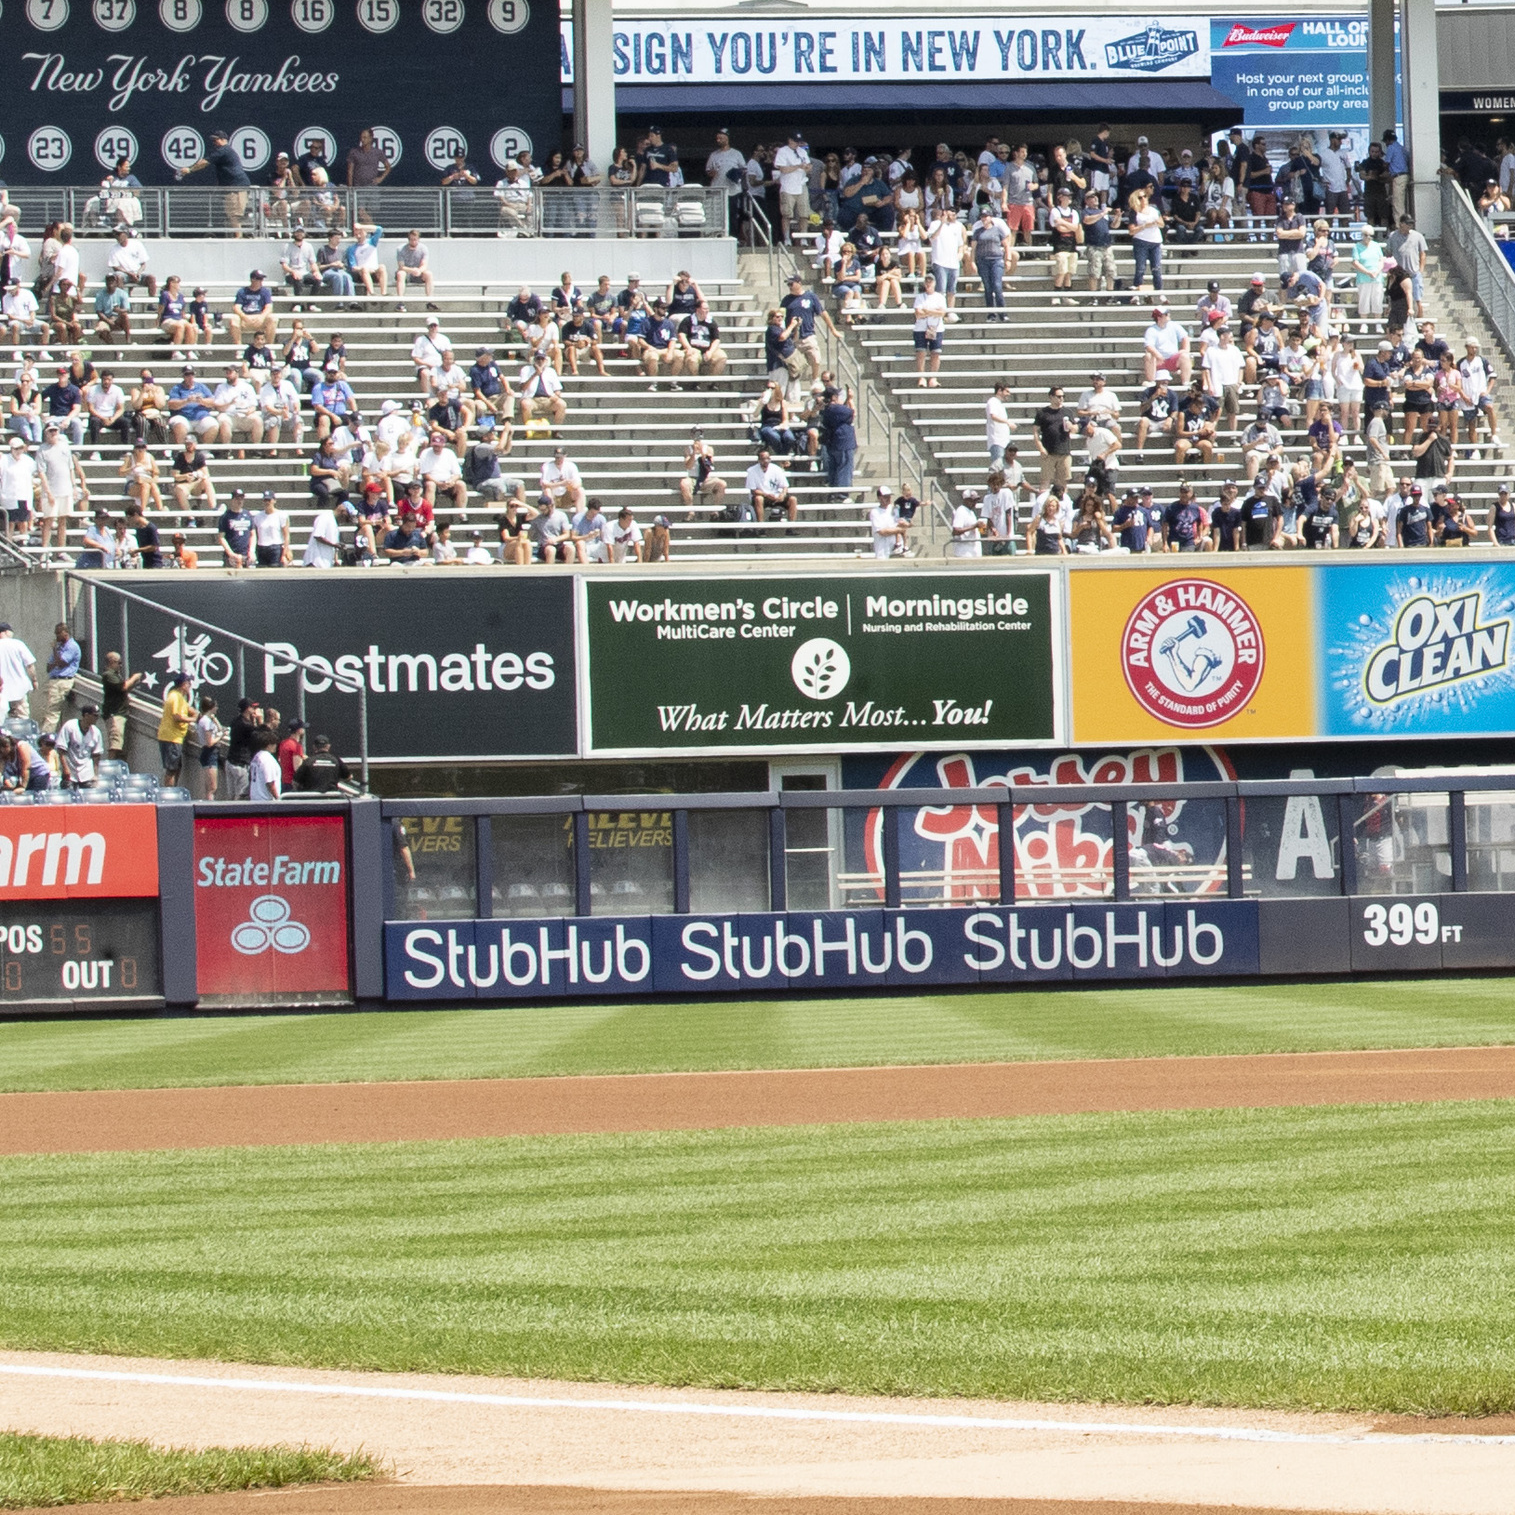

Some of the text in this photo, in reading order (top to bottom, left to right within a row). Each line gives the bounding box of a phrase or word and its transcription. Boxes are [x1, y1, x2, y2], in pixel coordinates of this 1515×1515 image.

[41, 0, 54, 19] 7
[100, 0, 128, 20] 37
[173, 0, 188, 20] 8
[240, 1, 254, 21] 8
[301, 1, 324, 22] 16
[367, 1, 390, 22] 15
[429, 2, 458, 23] 32
[501, 2, 516, 23] 9
[1229, 26, 1290, 42] Budweiser
[1303, 22, 1345, 35] HALL
[613, 31, 694, 75] SIGN
[708, 30, 839, 75] YOU'RE
[851, 31, 886, 73] IN
[903, 29, 982, 73] NEW
[994, 27, 1098, 72] YORK.
[1160, 32, 1195, 53] POINT
[1105, 44, 1146, 65] BLUE
[22, 52, 340, 113] New York Yankees
[1236, 73, 1362, 87] Host your next group
[1247, 87, 1258, 96] in
[1261, 88, 1287, 96] one
[1289, 86, 1299, 96] of
[1303, 87, 1323, 96] our
[1268, 101, 1304, 112] group
[1308, 100, 1339, 112] party
[36, 138, 64, 159] 23
[101, 138, 130, 159] 49
[167, 138, 197, 159] 42
[242, 139, 256, 160] 6
[504, 139, 518, 160] 2
[609, 596, 838, 624] Workmen's Circle
[866, 593, 1029, 619] Morningside
[657, 622, 796, 640] MultiCare Center
[862, 620, 1031, 634] Nursing and Rehabilitation Center
[1129, 585, 1257, 668] ARM & HAMMER
[1397, 592, 1480, 651] OXI
[264, 642, 556, 694] Postmates
[1365, 620, 1511, 703] CLEAN
[1144, 679, 1244, 715] THE STANDARD OF PURITY
[657, 704, 728, 732] What
[734, 703, 832, 731] Matters
[932, 699, 993, 725] You!
[1363, 903, 1463, 946] 399 FT
[681, 917, 933, 981] StubHub
[964, 909, 1223, 973] StubHub
[404, 923, 651, 989] StubHub
[62, 960, 114, 989] OUT
